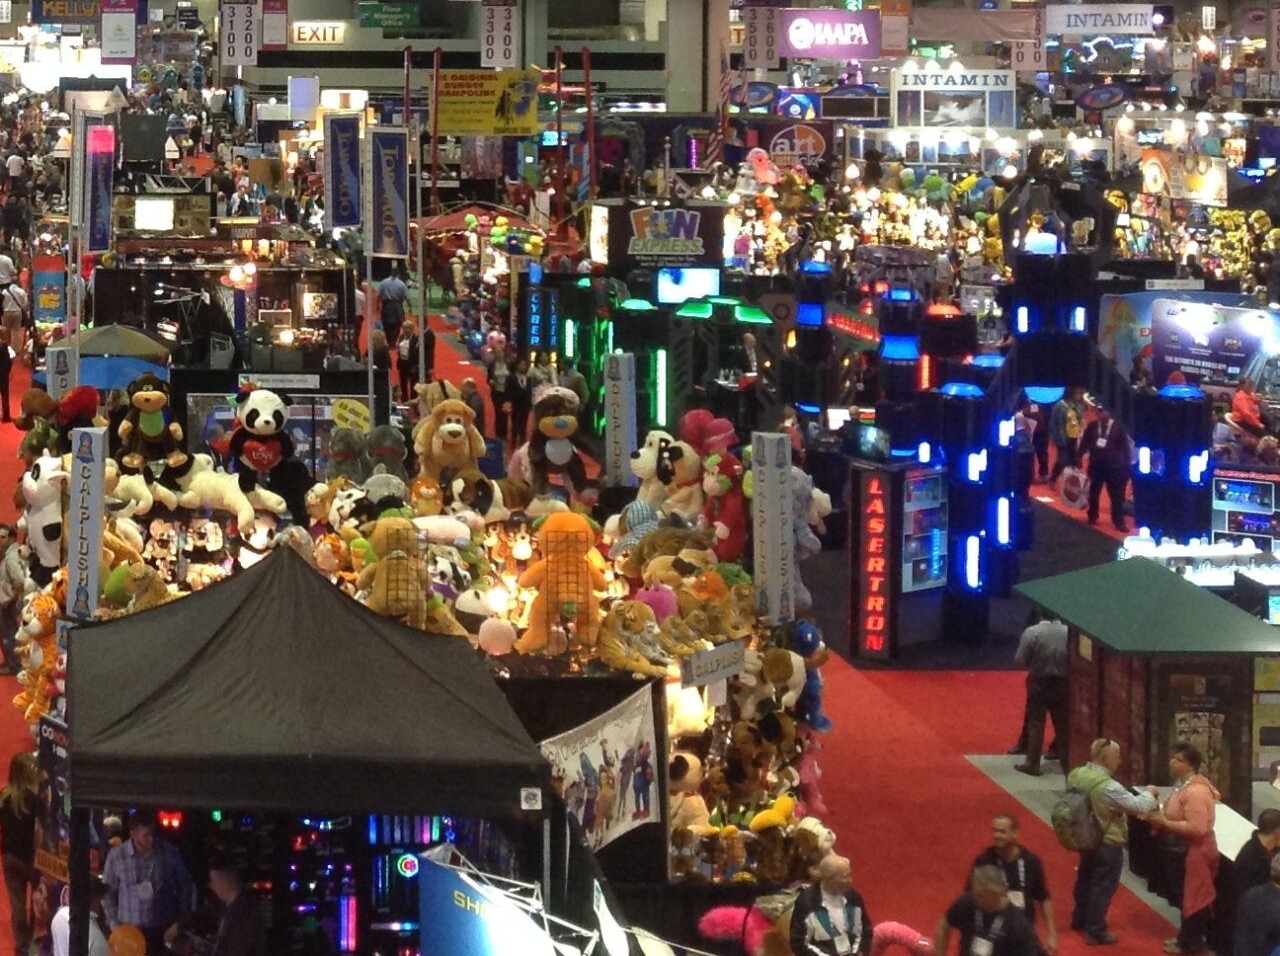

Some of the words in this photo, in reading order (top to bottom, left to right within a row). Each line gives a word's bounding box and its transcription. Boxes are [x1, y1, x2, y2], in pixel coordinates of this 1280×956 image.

[1065, 12, 1148, 28] INTAMIN
[297, 26, 340, 41] EXIT
[901, 74, 1009, 86] INTAMIN
[630, 206, 702, 241] FUN
[629, 238, 704, 254] EXPRESS
[865, 477, 886, 651] LASERTRON
